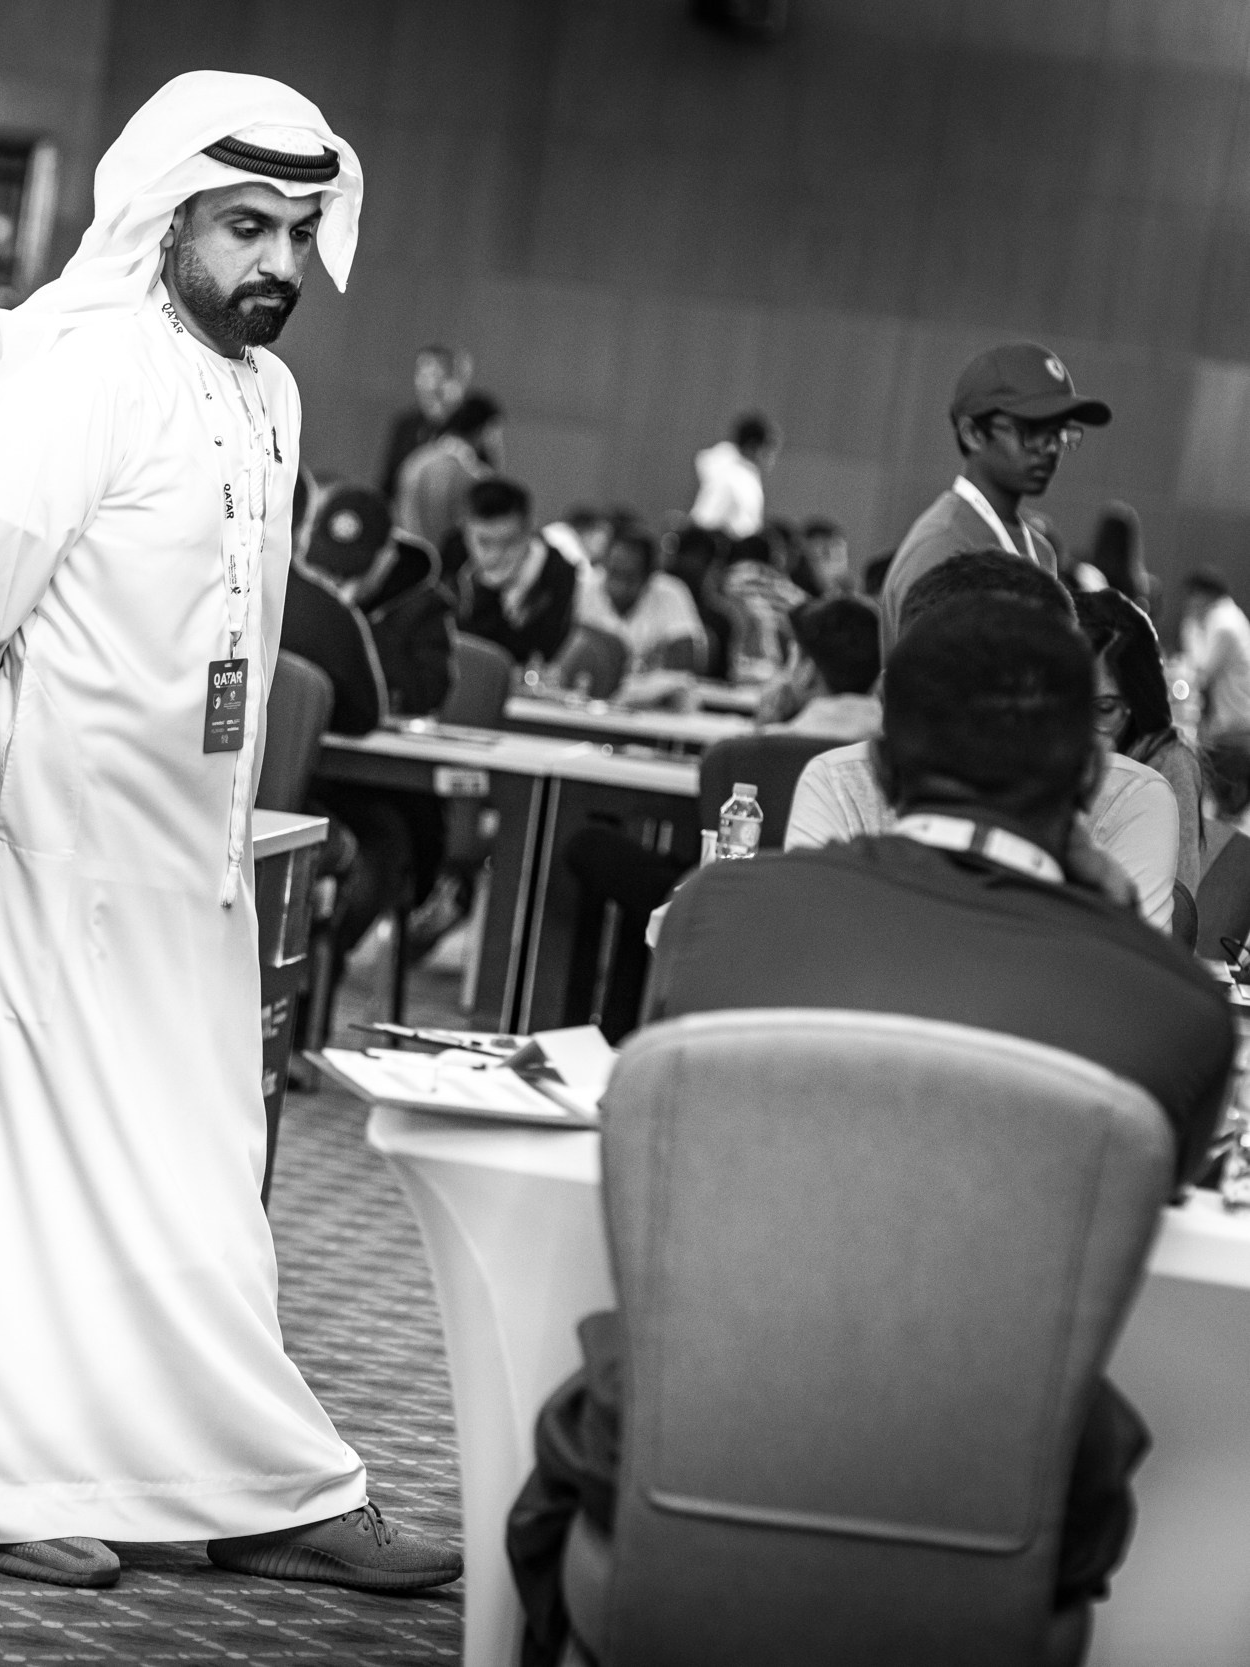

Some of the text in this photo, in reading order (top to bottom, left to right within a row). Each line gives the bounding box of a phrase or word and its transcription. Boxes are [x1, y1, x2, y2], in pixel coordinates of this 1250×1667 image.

[161, 302, 184, 335] QATAR
[223, 483, 235, 520] QATAR
[213, 670, 243, 689] QATAR
